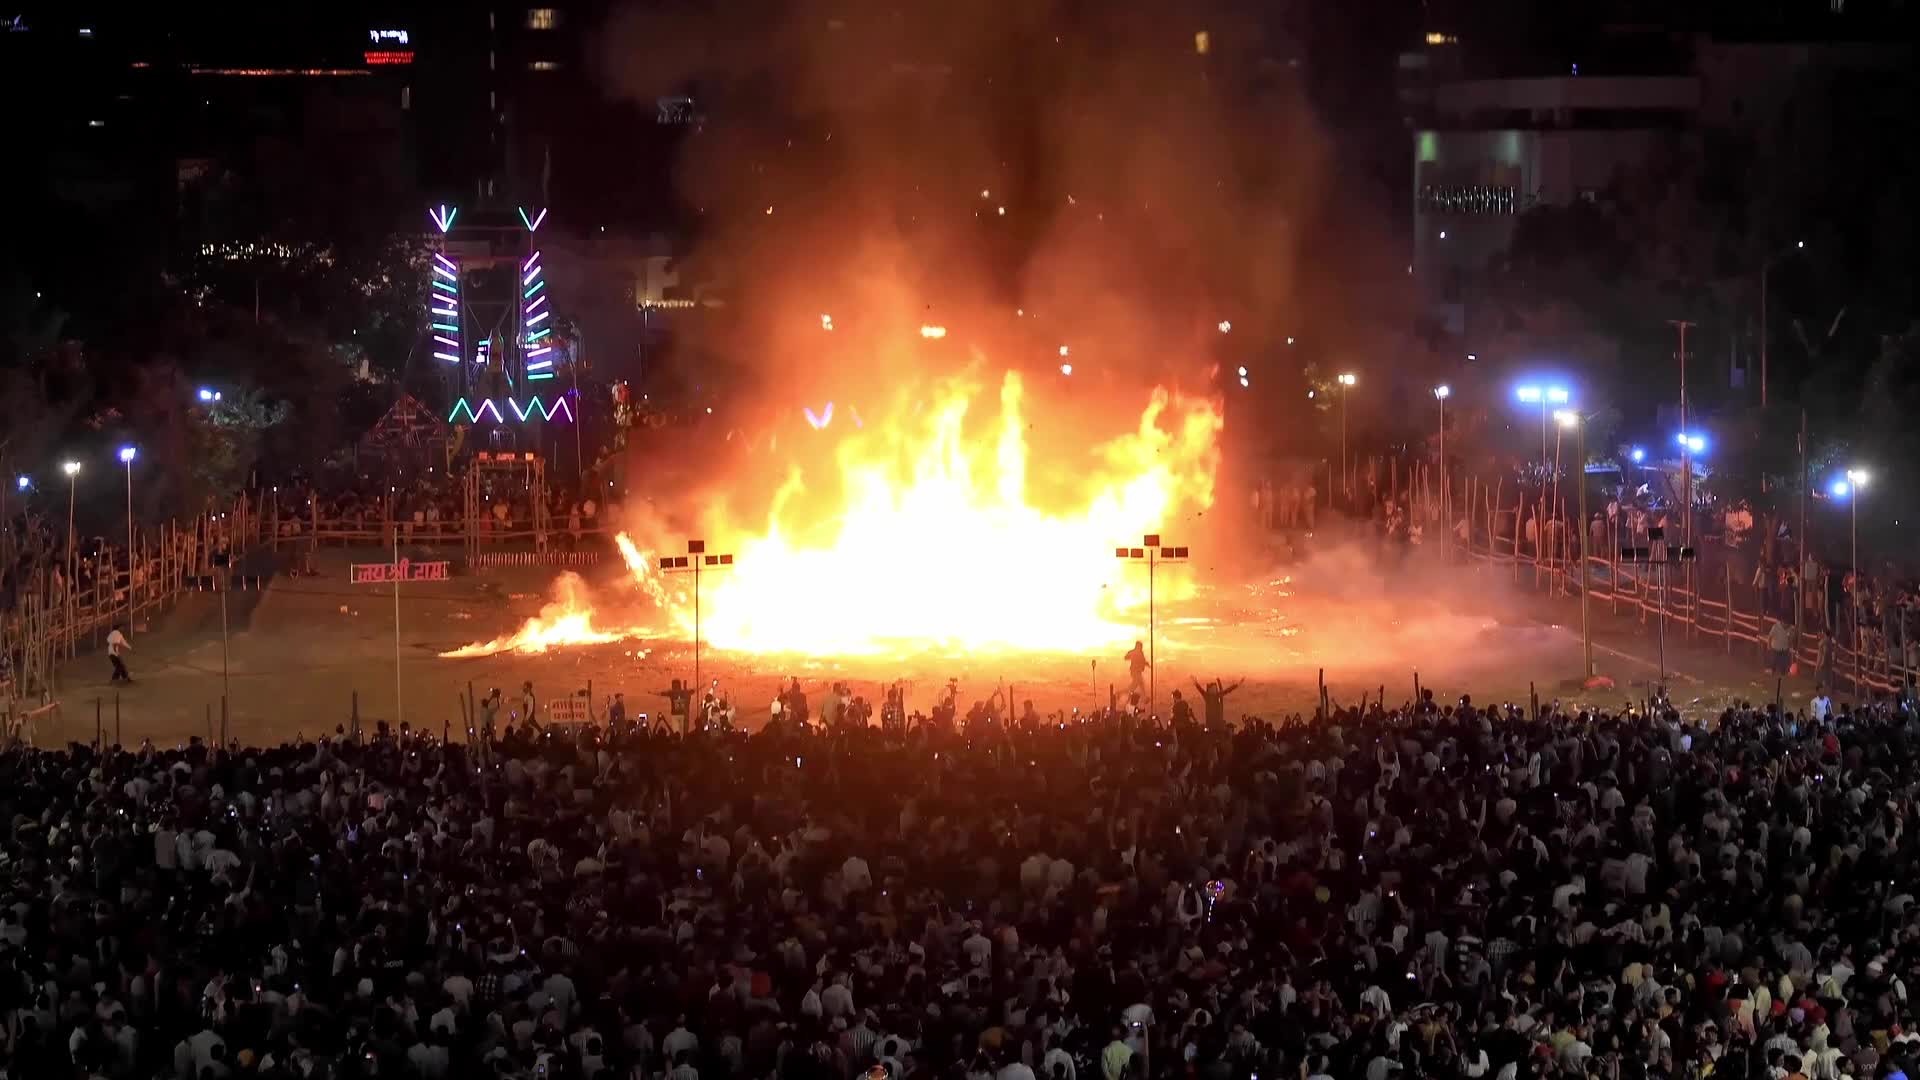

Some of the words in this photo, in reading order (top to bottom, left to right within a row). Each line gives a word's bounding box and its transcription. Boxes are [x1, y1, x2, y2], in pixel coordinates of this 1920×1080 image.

[358, 564, 385, 583] जय
[388, 558, 409, 581] श्री
[415, 561, 446, 581] राम
